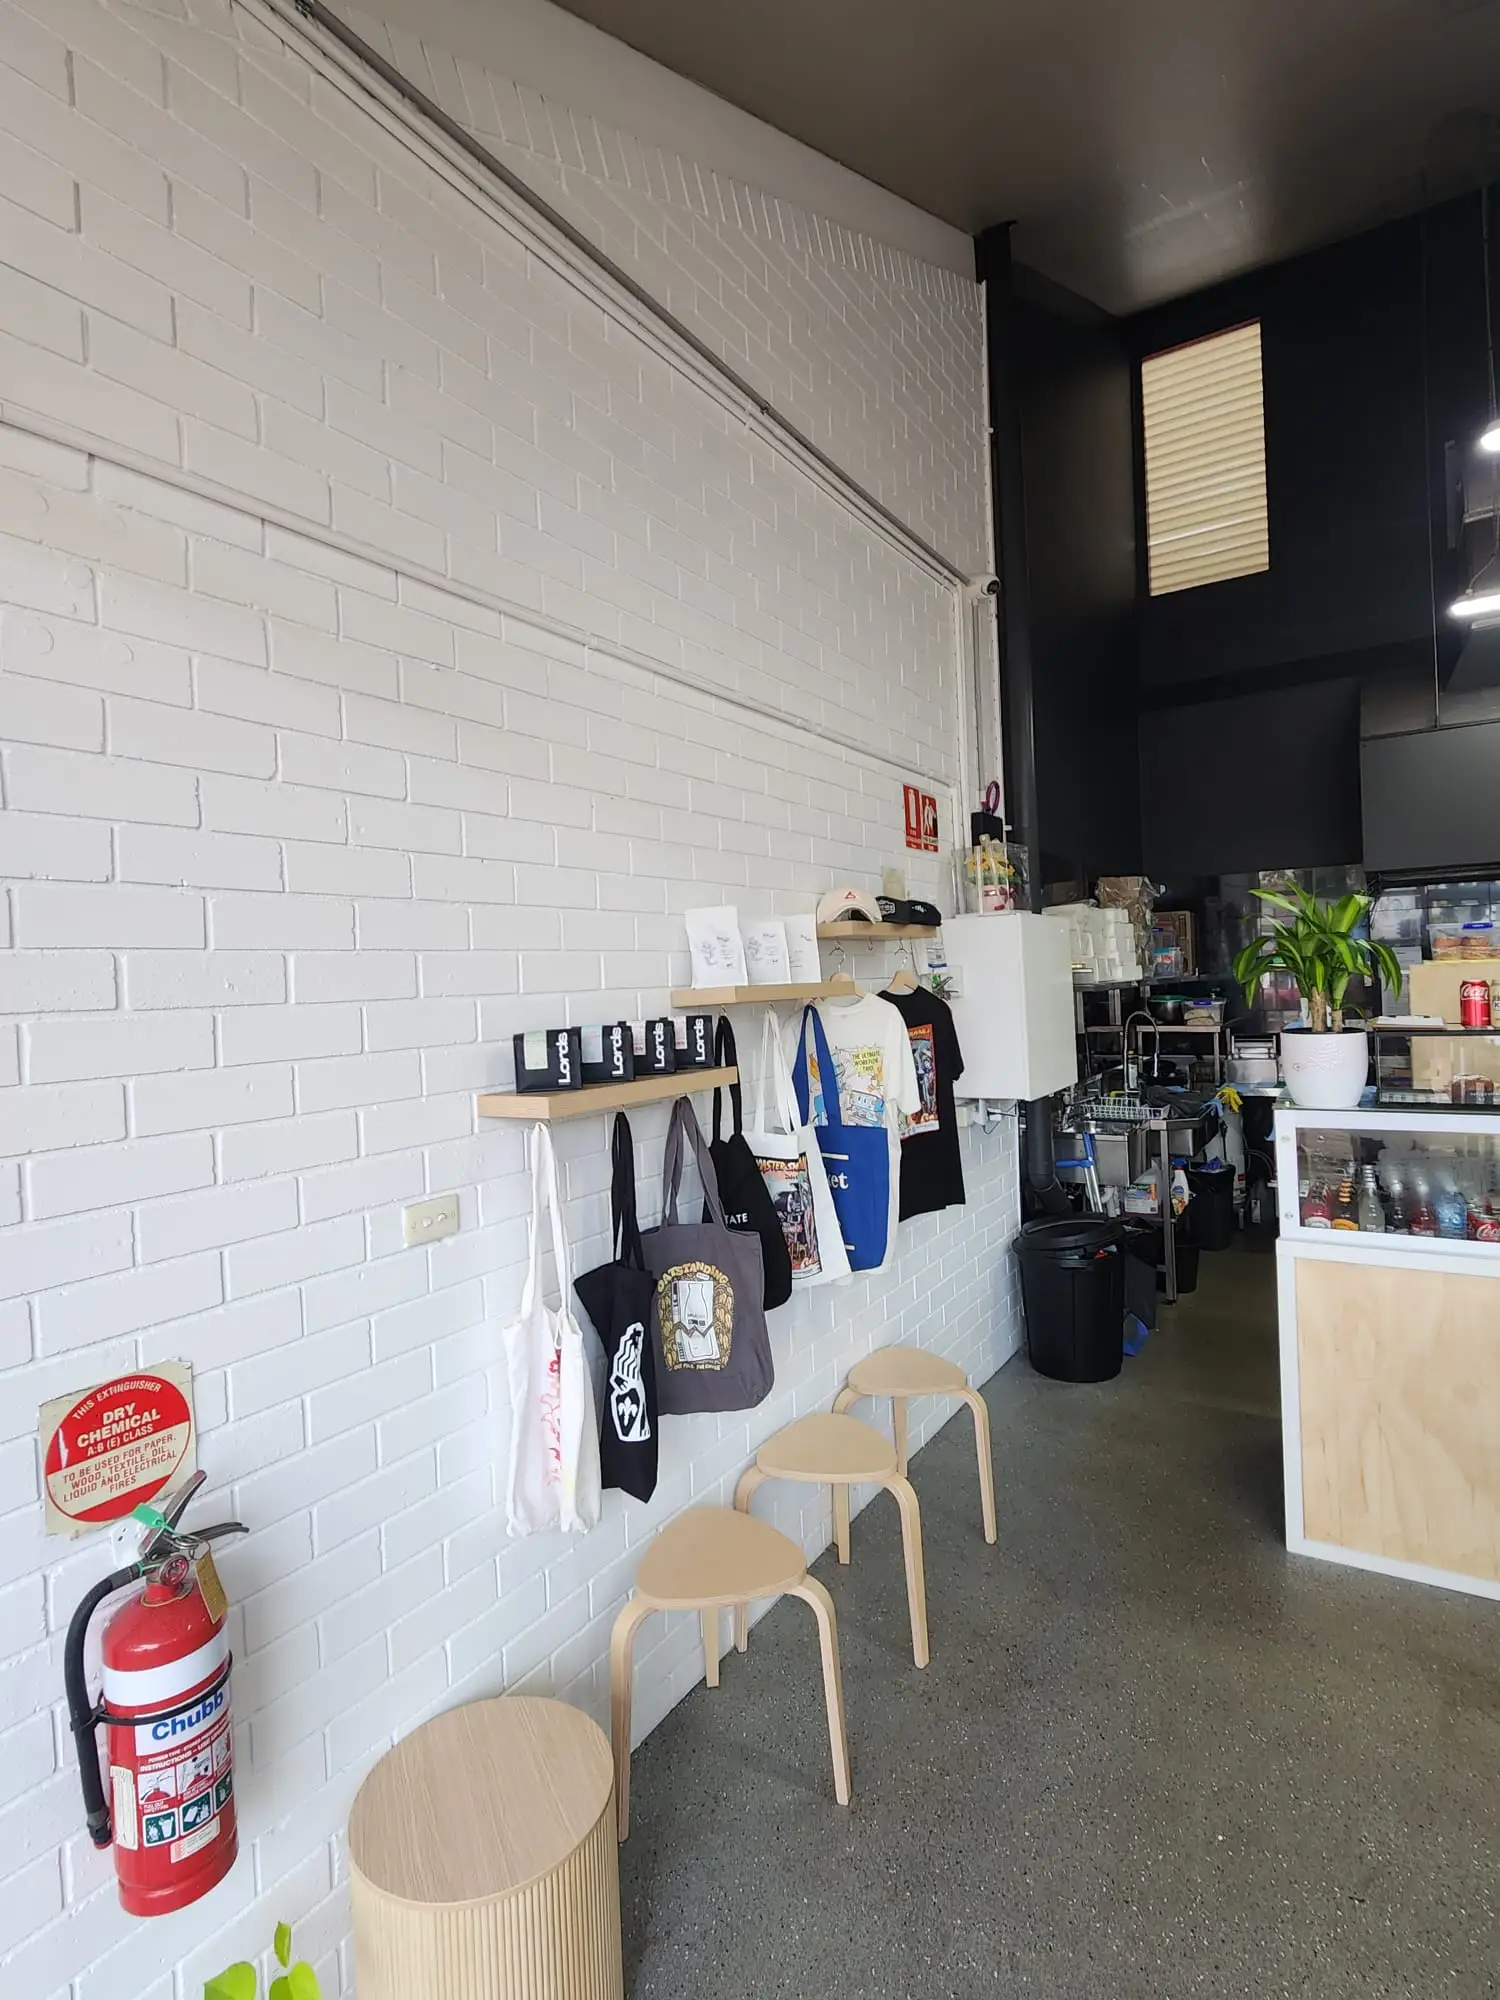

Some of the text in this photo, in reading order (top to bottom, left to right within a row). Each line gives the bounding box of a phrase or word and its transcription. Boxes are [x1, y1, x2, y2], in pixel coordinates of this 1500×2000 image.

[555, 1032, 570, 1085] Lords
[610, 1027, 624, 1077] Lords
[652, 1022, 665, 1069] Lords
[693, 1018, 705, 1062] Lords
[72, 1380, 162, 1420] THIS EXTINGUISHER
[102, 1402, 136, 1425] DRY
[77, 1408, 161, 1448] CHEMICAL
[106, 1437, 120, 1451] (E)
[123, 1424, 154, 1442] CLASS
[62, 1473, 75, 1484] TO
[79, 1465, 92, 1478] BE
[94, 1455, 120, 1471] USED
[123, 1446, 141, 1460] FOR
[63, 1449, 177, 1502] LIQUID AND ELECTRICAL
[109, 1475, 137, 1493] FIRES
[152, 1691, 224, 1741] Chubb
